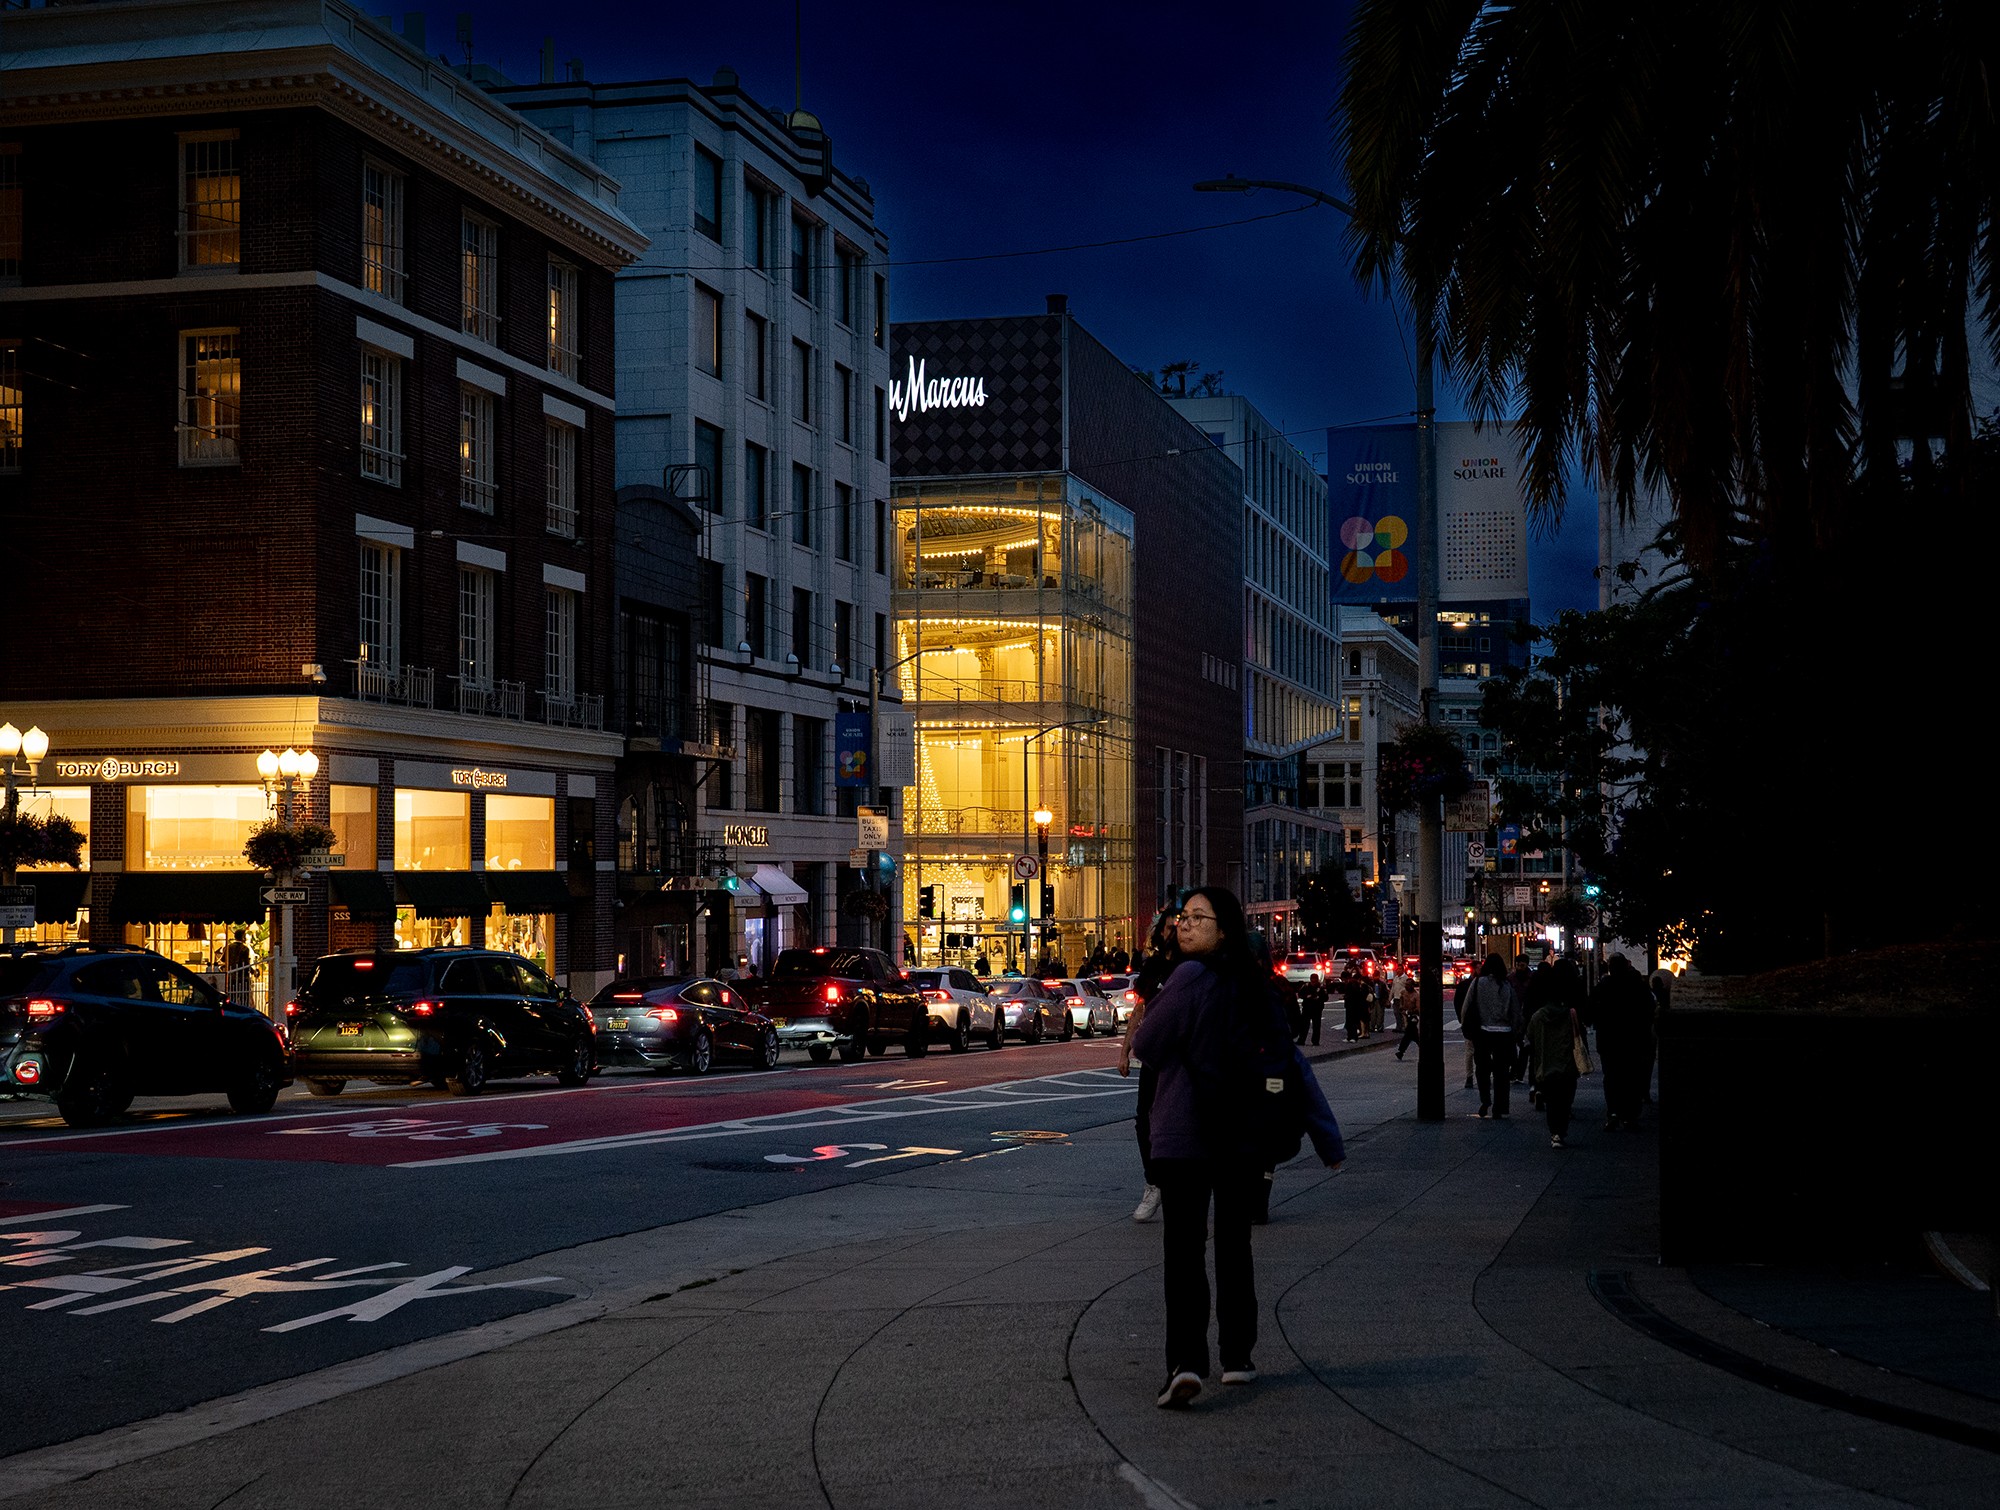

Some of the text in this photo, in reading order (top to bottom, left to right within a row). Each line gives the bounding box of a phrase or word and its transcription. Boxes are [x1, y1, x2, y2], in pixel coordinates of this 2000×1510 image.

[899, 355, 989, 423] Marcus
[1355, 463, 1391, 472] UNION
[1462, 458, 1498, 468] UNION
[1346, 472, 1399, 486] SQUARE
[1454, 467, 1506, 483] SQUARE
[57, 762, 179, 776] TORY BURCH
[1458, 803, 1475, 812] ANY
[1458, 814, 1477, 822] TIME
[724, 825, 770, 846] MONCLER
[299, 856, 342, 864] AIDEN LANE
